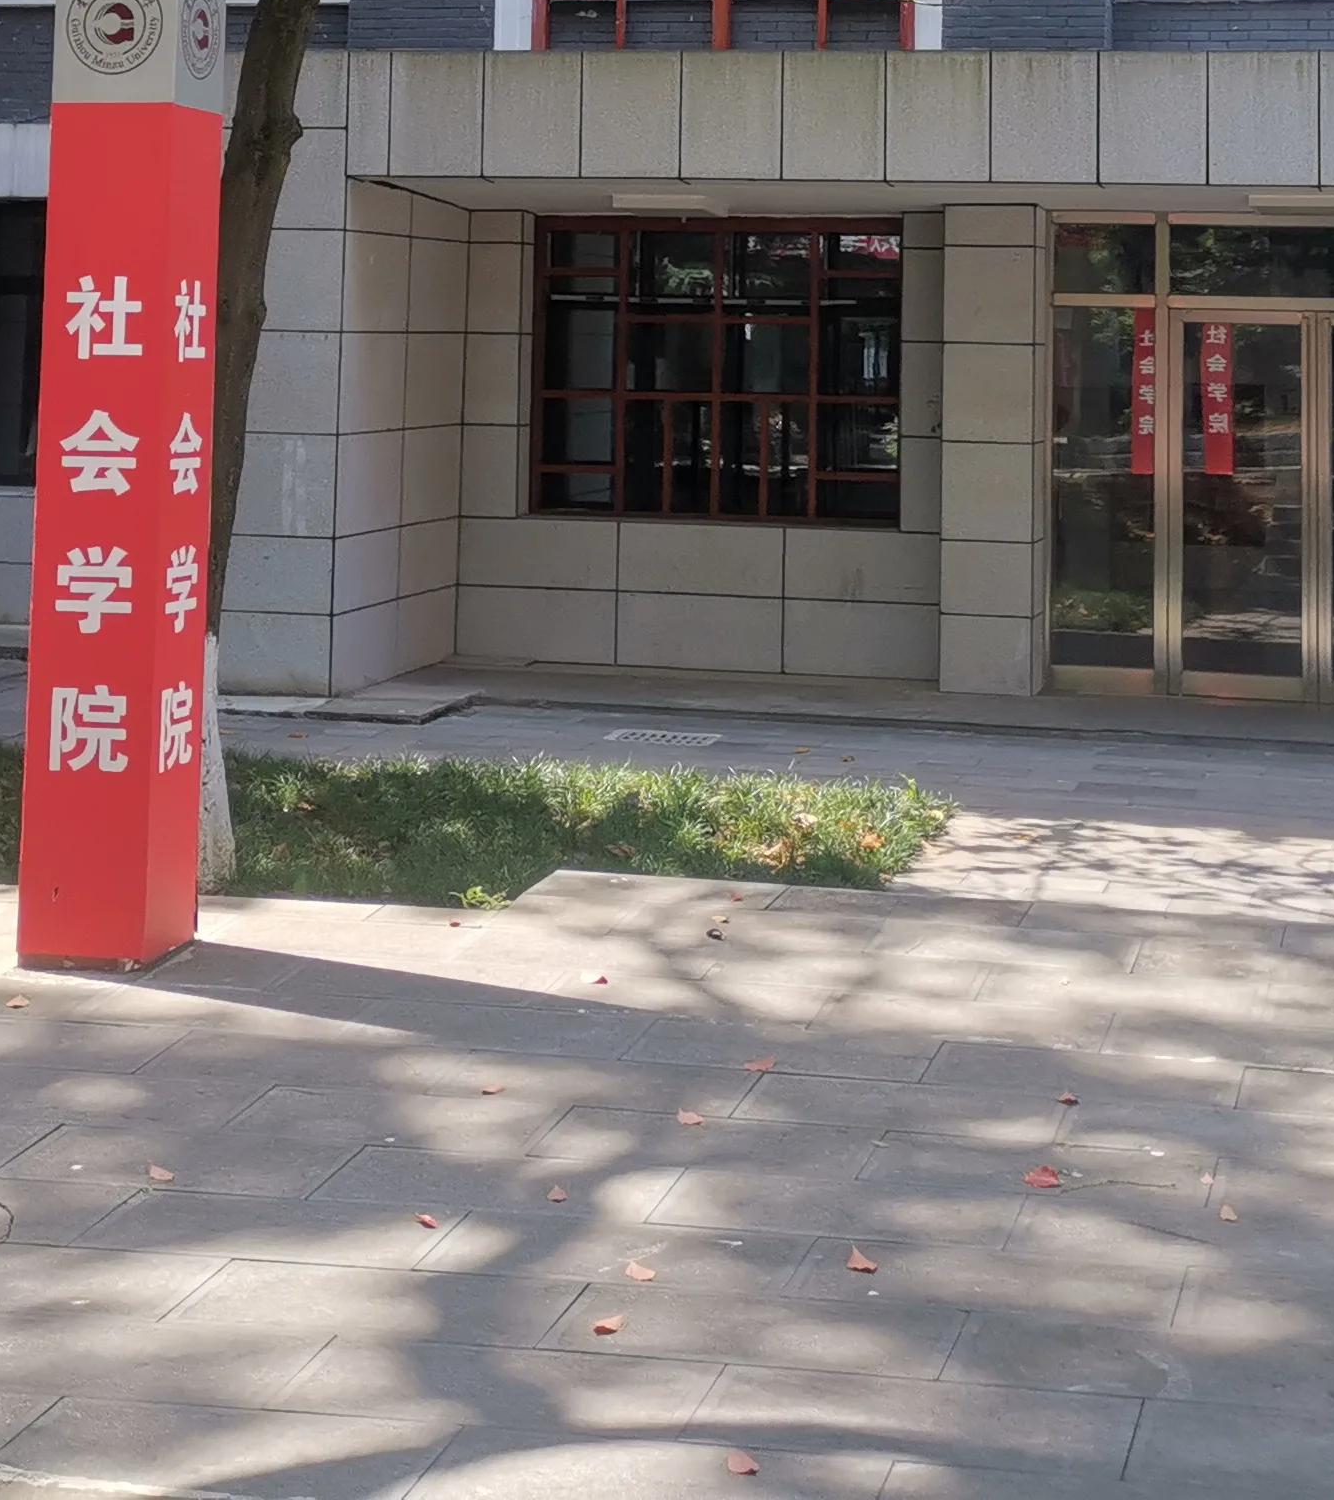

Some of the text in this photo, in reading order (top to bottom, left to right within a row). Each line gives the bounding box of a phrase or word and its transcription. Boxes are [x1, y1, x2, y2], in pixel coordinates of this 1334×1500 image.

[125, 16, 160, 65] University
[48, 275, 143, 773] 社会学院
[157, 278, 208, 775] 社会学院
